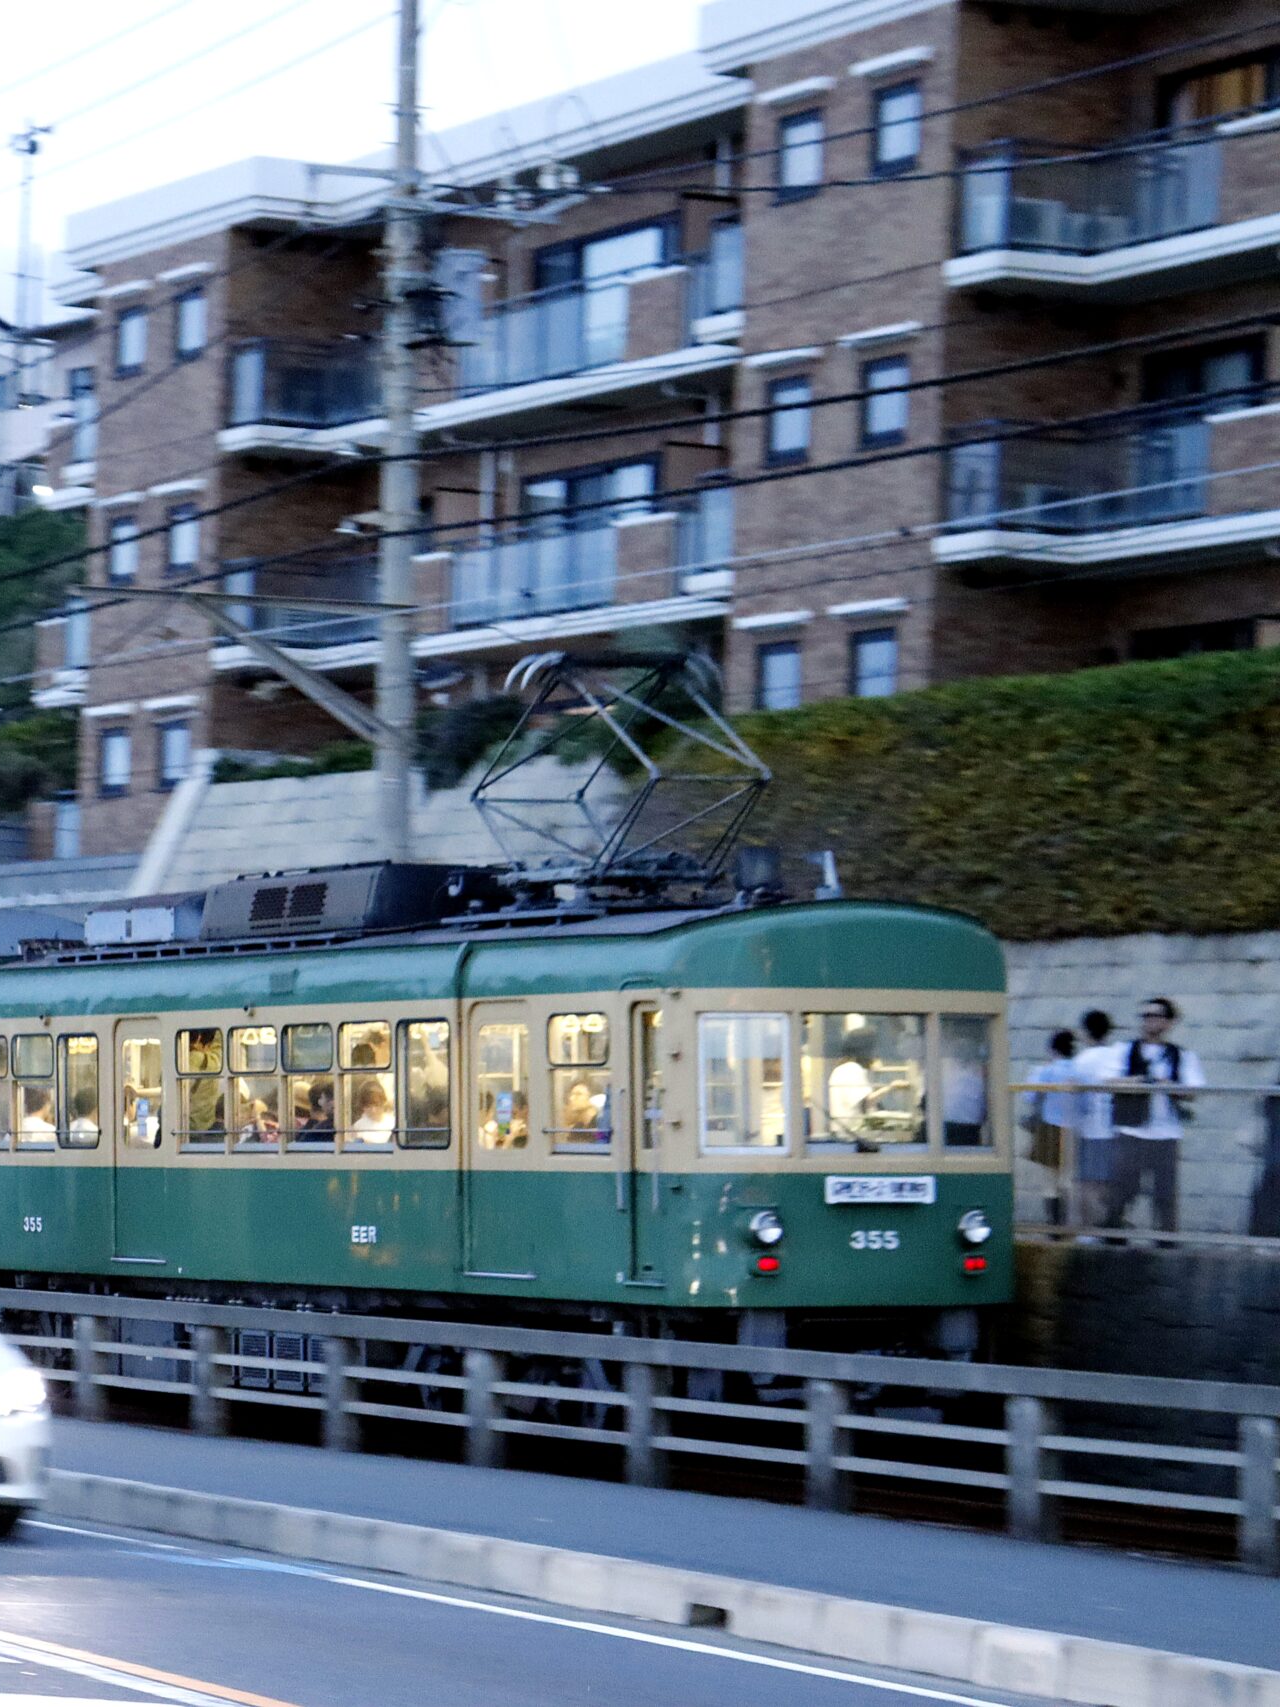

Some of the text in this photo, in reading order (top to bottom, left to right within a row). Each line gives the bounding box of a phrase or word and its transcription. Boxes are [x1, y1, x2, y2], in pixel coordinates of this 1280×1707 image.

[23, 1216, 42, 1232] 355
[351, 1225, 376, 1243] EER
[849, 1230, 900, 1250] 355
